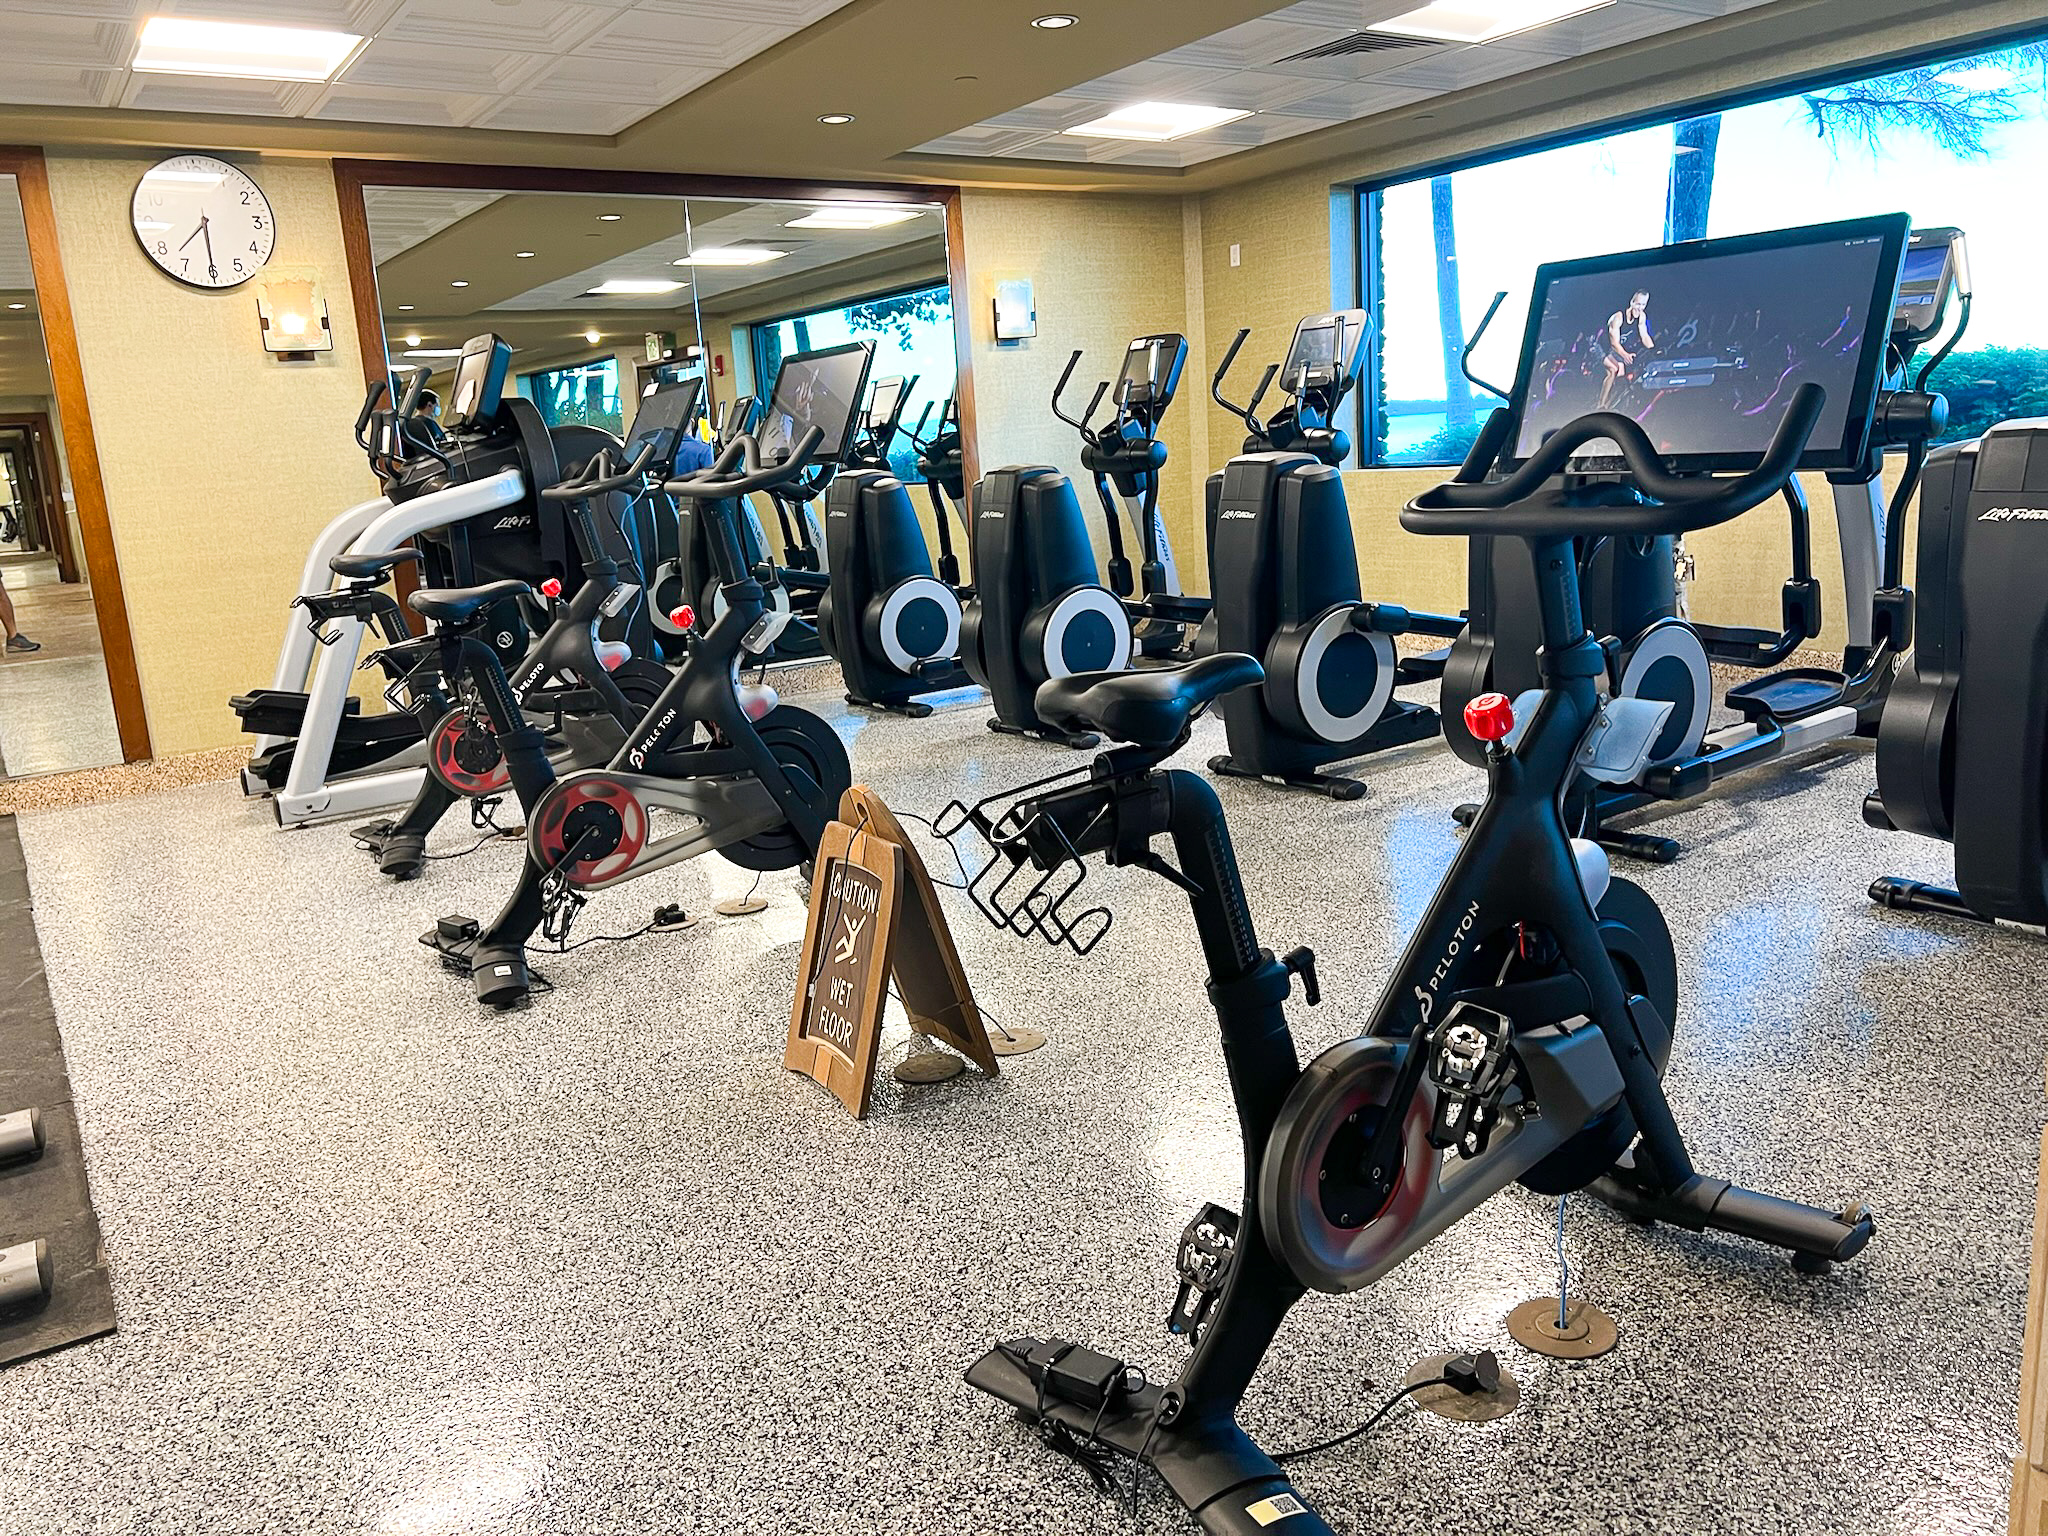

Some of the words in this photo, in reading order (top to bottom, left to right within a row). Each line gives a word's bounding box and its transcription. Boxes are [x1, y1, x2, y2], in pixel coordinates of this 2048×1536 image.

[240, 191, 250, 205] 2
[252, 216, 263, 230] 3
[157, 241, 168, 255] 8
[249, 241, 258, 254] 4
[180, 258, 189, 272] 7
[208, 264, 219, 279] 6
[233, 258, 243, 272] 5
[640, 708, 677, 753] PELOTON
[1429, 900, 1480, 991] PELOTON
[830, 975, 854, 1009] WET
[819, 1005, 854, 1049] FLOOR
